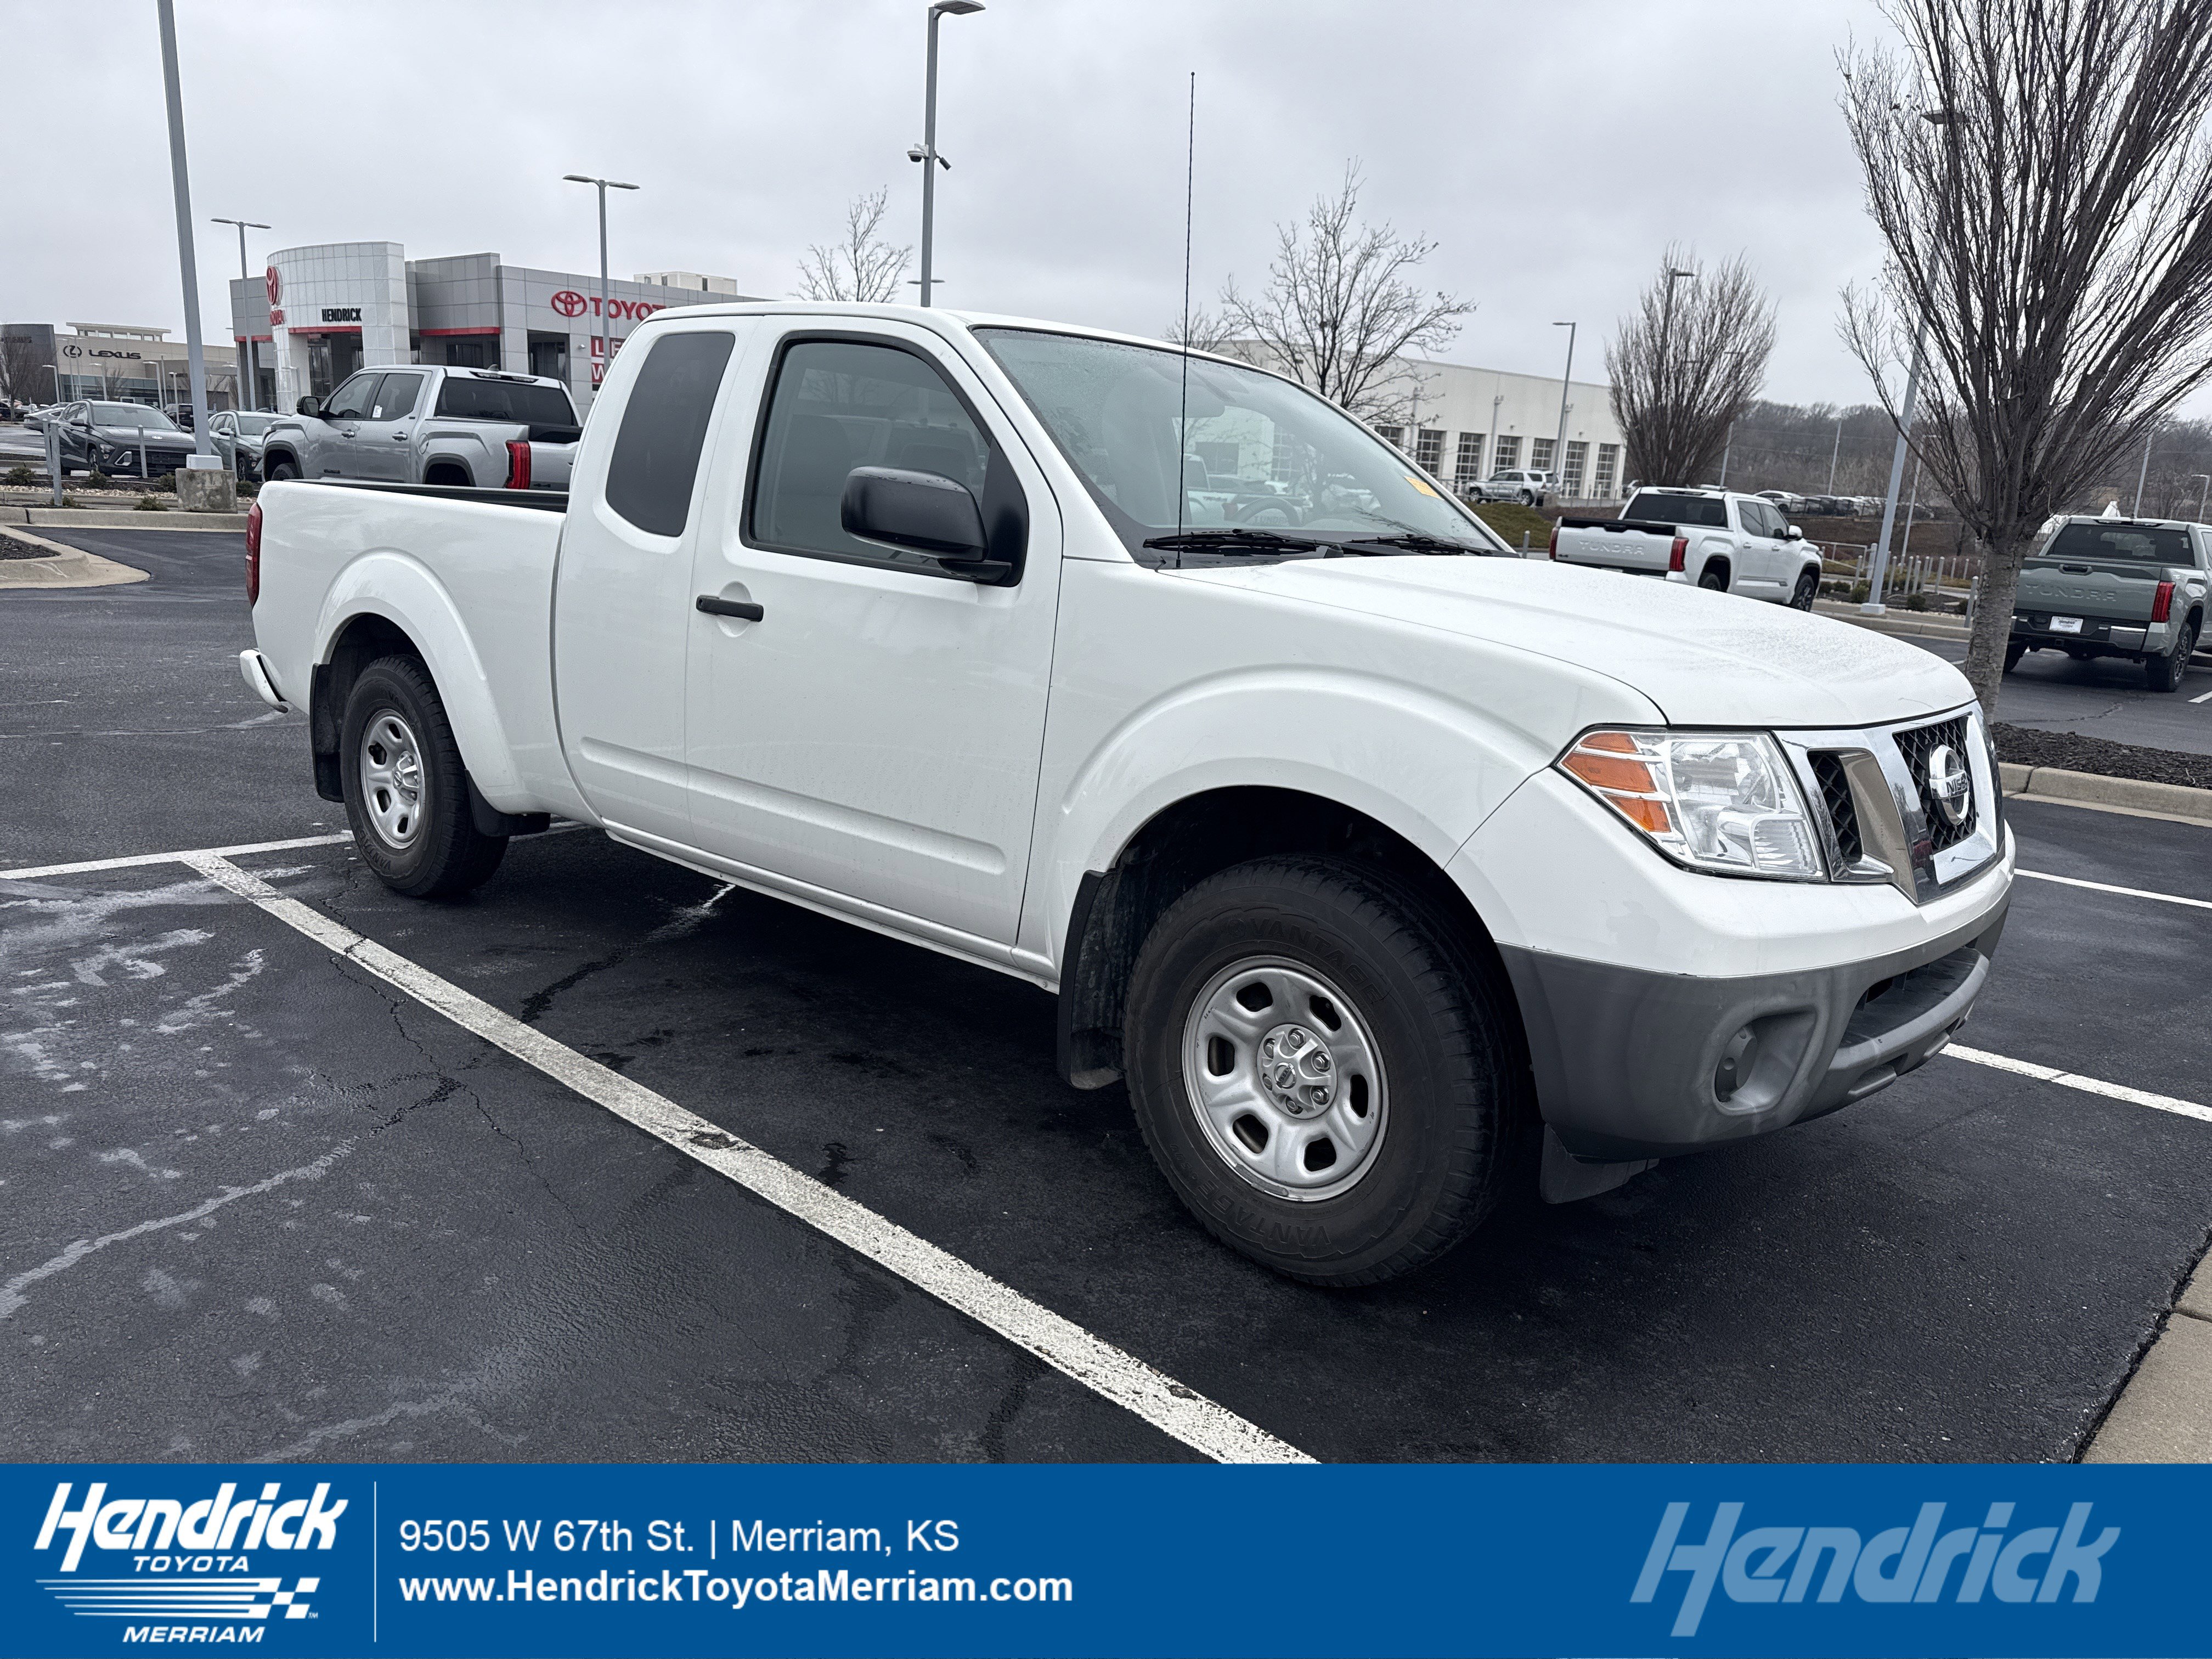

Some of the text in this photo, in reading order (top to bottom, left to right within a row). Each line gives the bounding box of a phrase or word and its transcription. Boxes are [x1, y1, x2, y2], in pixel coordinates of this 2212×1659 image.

[321, 308, 362, 322] HENDRICK
[590, 297, 667, 321] TOYO
[89, 349, 141, 359] LEXUS
[1579, 541, 1644, 555] TUNDRA
[2025, 584, 2117, 602] TUNDRA
[1246, 918, 1385, 1002] VANTAGE
[1198, 1180, 1331, 1246] VANTAGE
